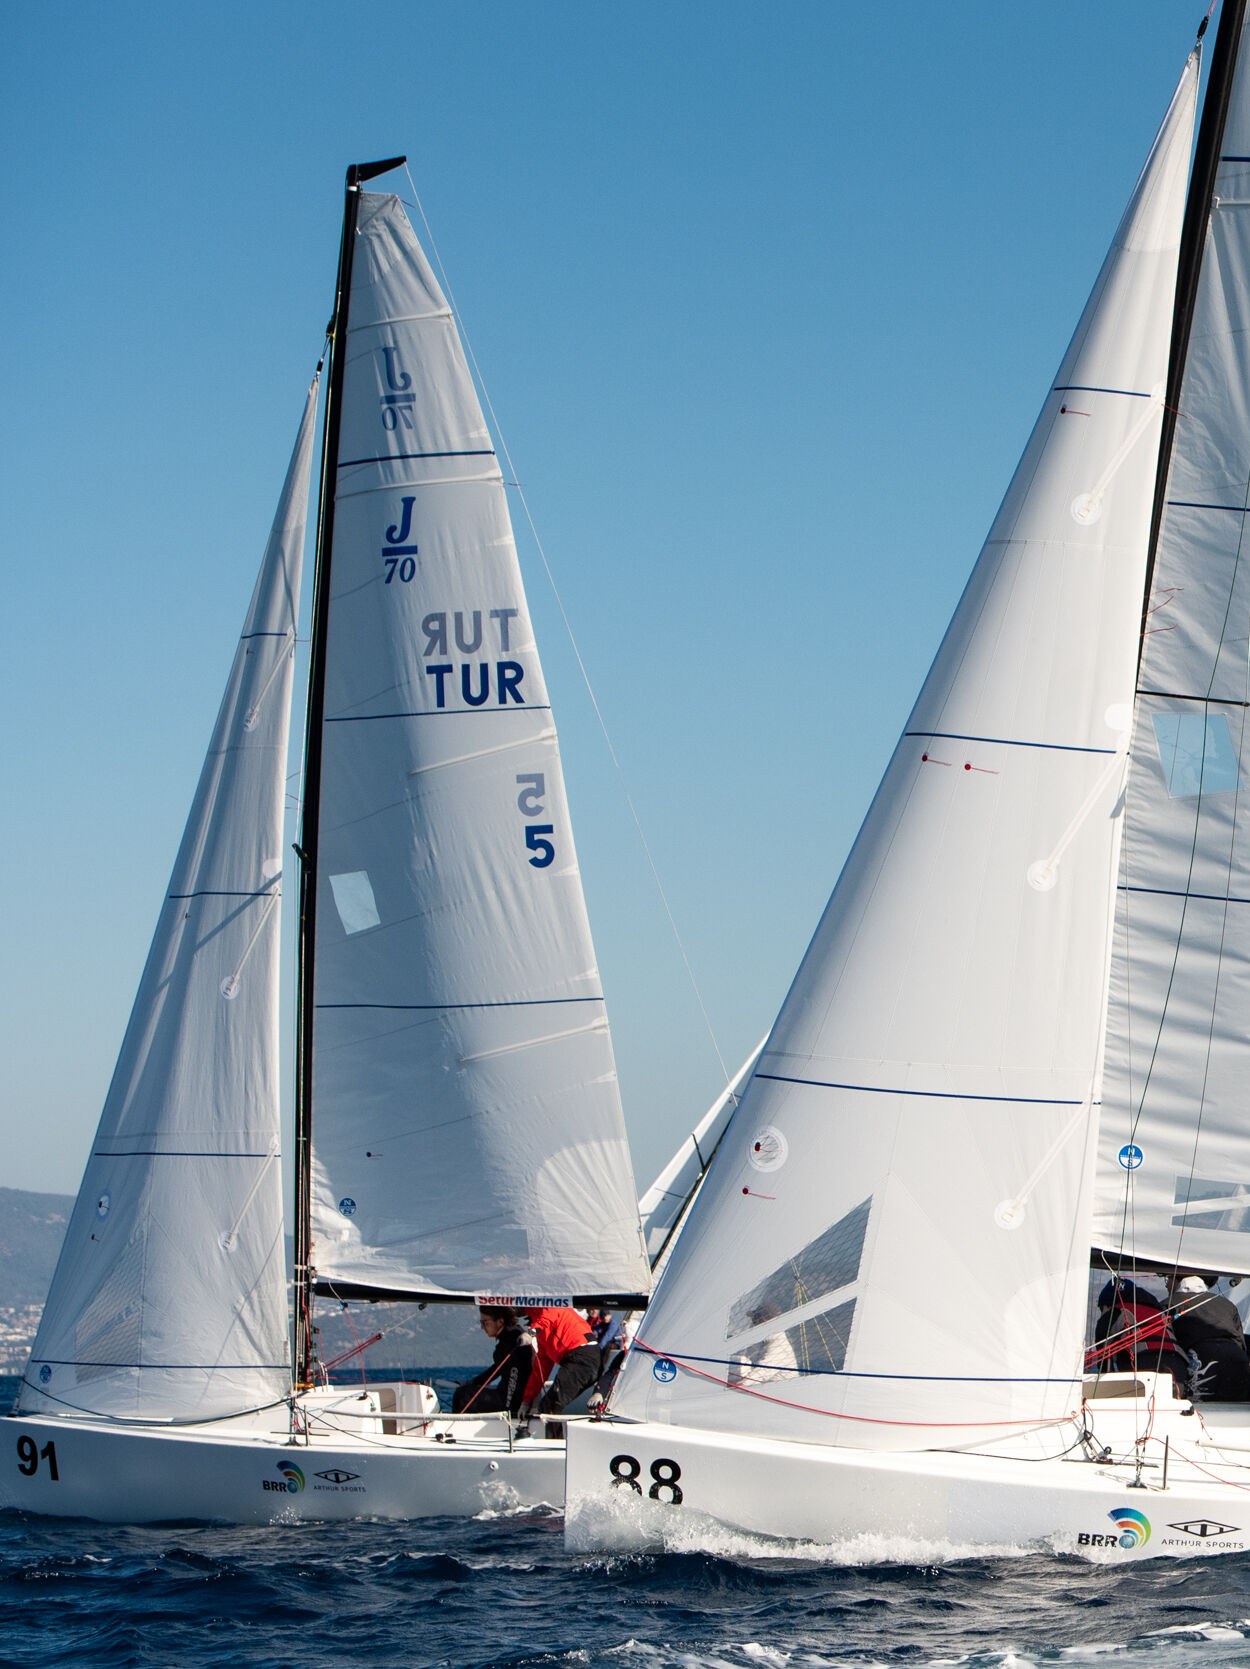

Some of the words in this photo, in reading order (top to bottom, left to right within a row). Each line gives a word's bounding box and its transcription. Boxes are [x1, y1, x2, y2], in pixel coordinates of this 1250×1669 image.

[385, 496, 417, 545] J
[383, 557, 416, 585] 70
[426, 660, 526, 708] TUR
[525, 824, 555, 869] 5
[17, 1435, 59, 1481] 91
[609, 1455, 683, 1505] 88
[313, 1484, 339, 1492] ARTHUR
[341, 1485, 366, 1493] SPORTS
[1161, 1538, 1202, 1548] ARTHUR
[1205, 1541, 1244, 1549] SPORTS
